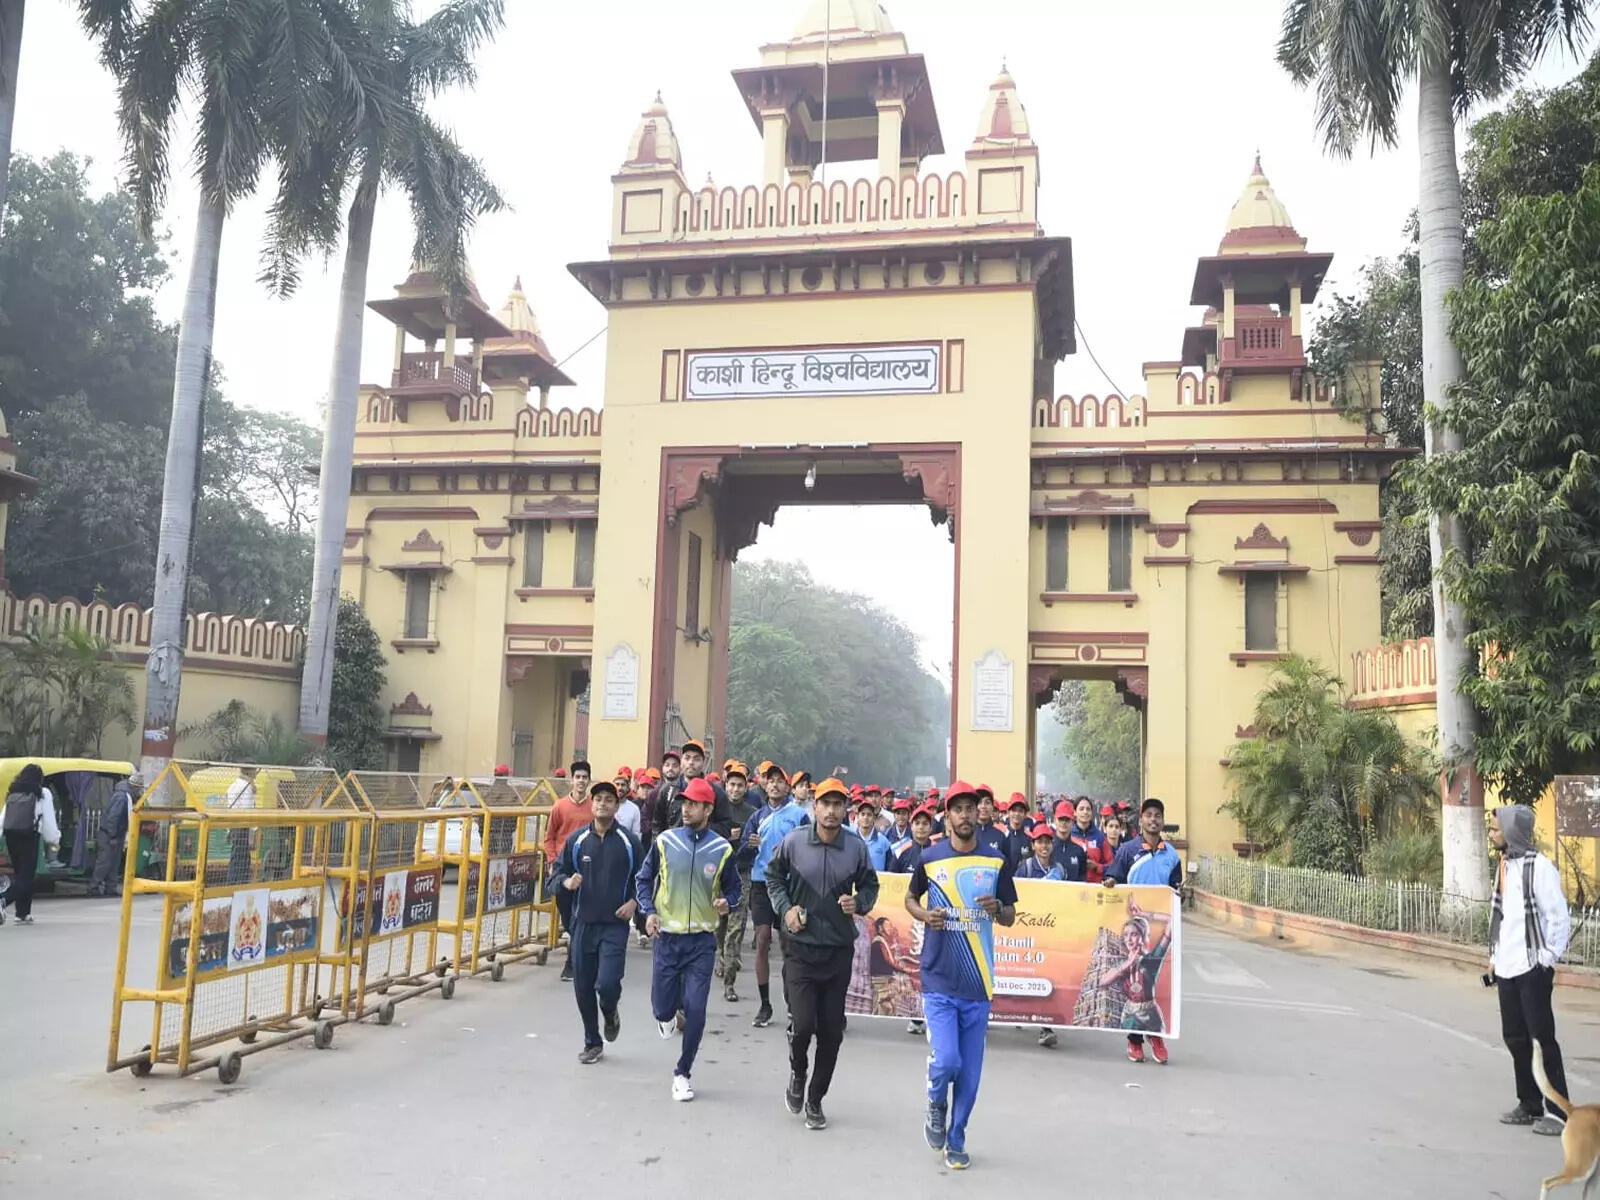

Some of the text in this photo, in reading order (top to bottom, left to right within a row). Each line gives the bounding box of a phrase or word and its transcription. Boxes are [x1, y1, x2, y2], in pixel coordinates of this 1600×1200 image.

[696, 354, 931, 390] काशी हिन्दू विश्वविद्यालय
[1015, 911, 1056, 928] Kashi
[1000, 936, 1034, 949] Tamil
